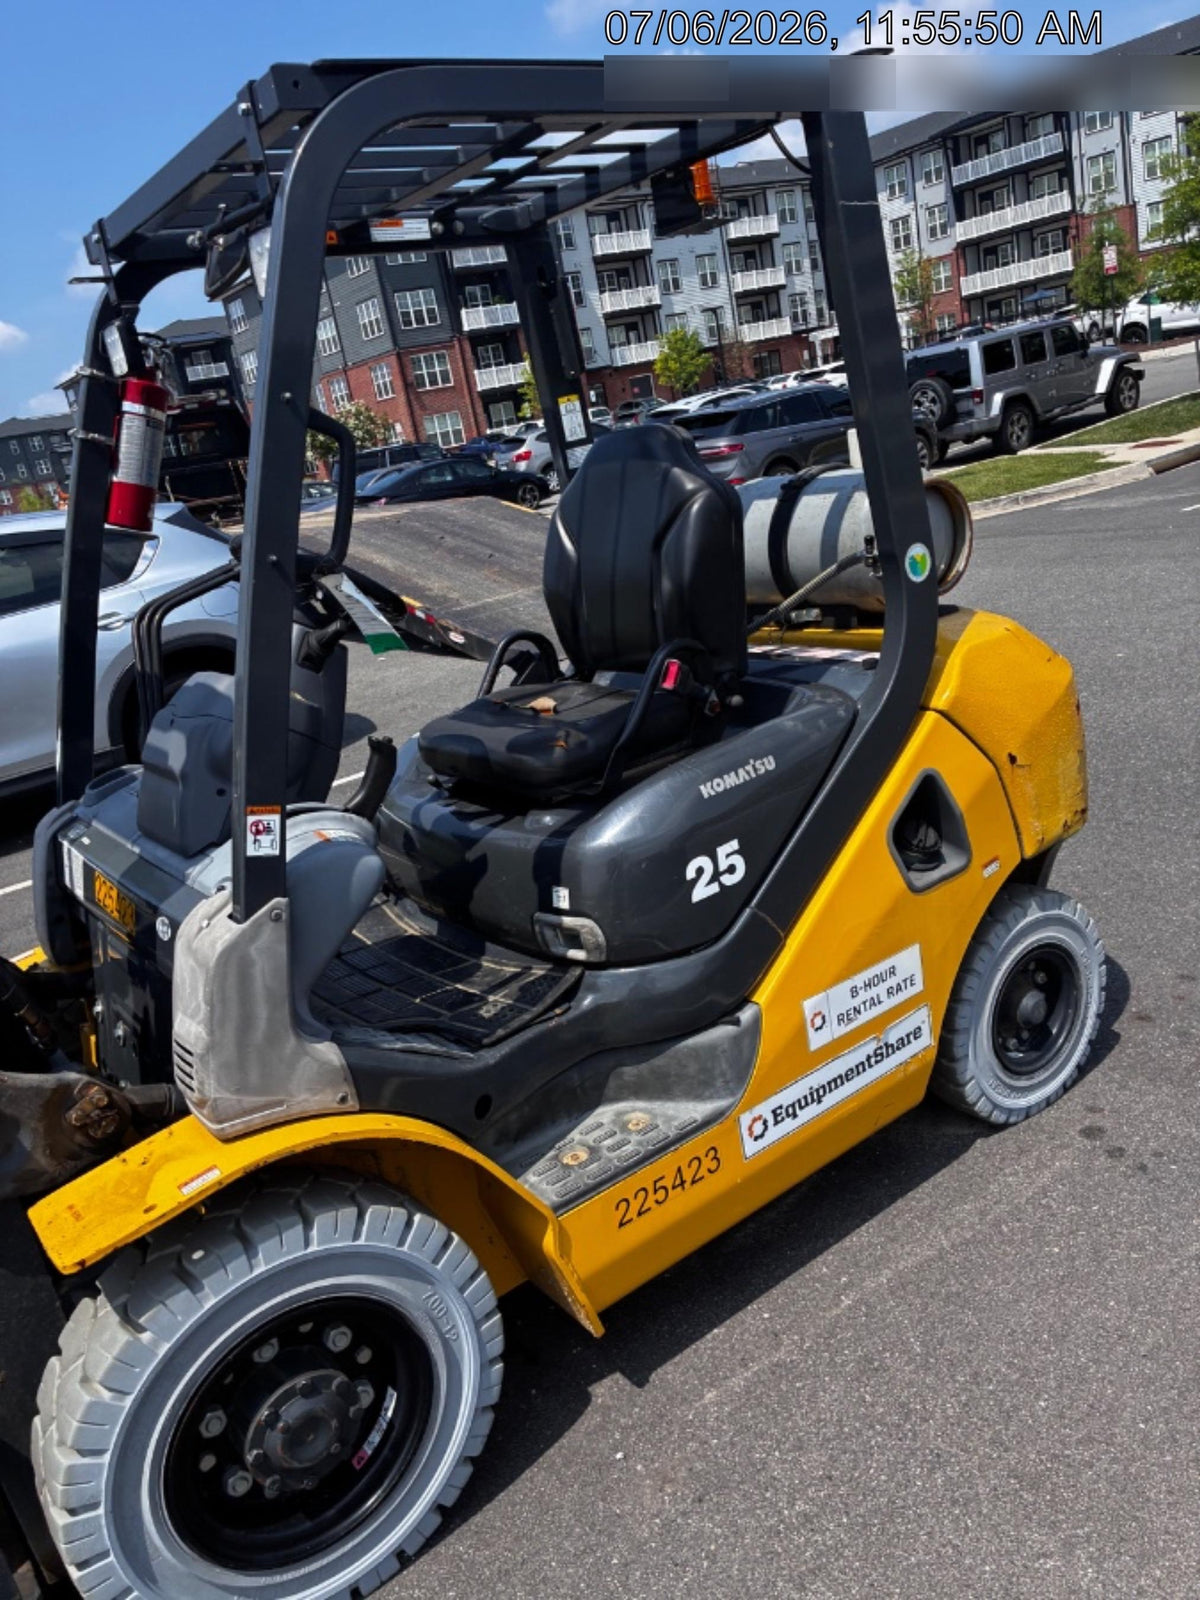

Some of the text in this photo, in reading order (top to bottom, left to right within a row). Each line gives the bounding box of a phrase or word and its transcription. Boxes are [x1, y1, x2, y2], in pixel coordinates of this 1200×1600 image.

[699, 755, 776, 799] KOMATSU
[686, 838, 746, 904] 25
[837, 973, 917, 1027] RENTAL RATE
[850, 964, 897, 999] 8-HOUR
[770, 1024, 924, 1128] EquipmentShare
[615, 1145, 721, 1230] 225423
